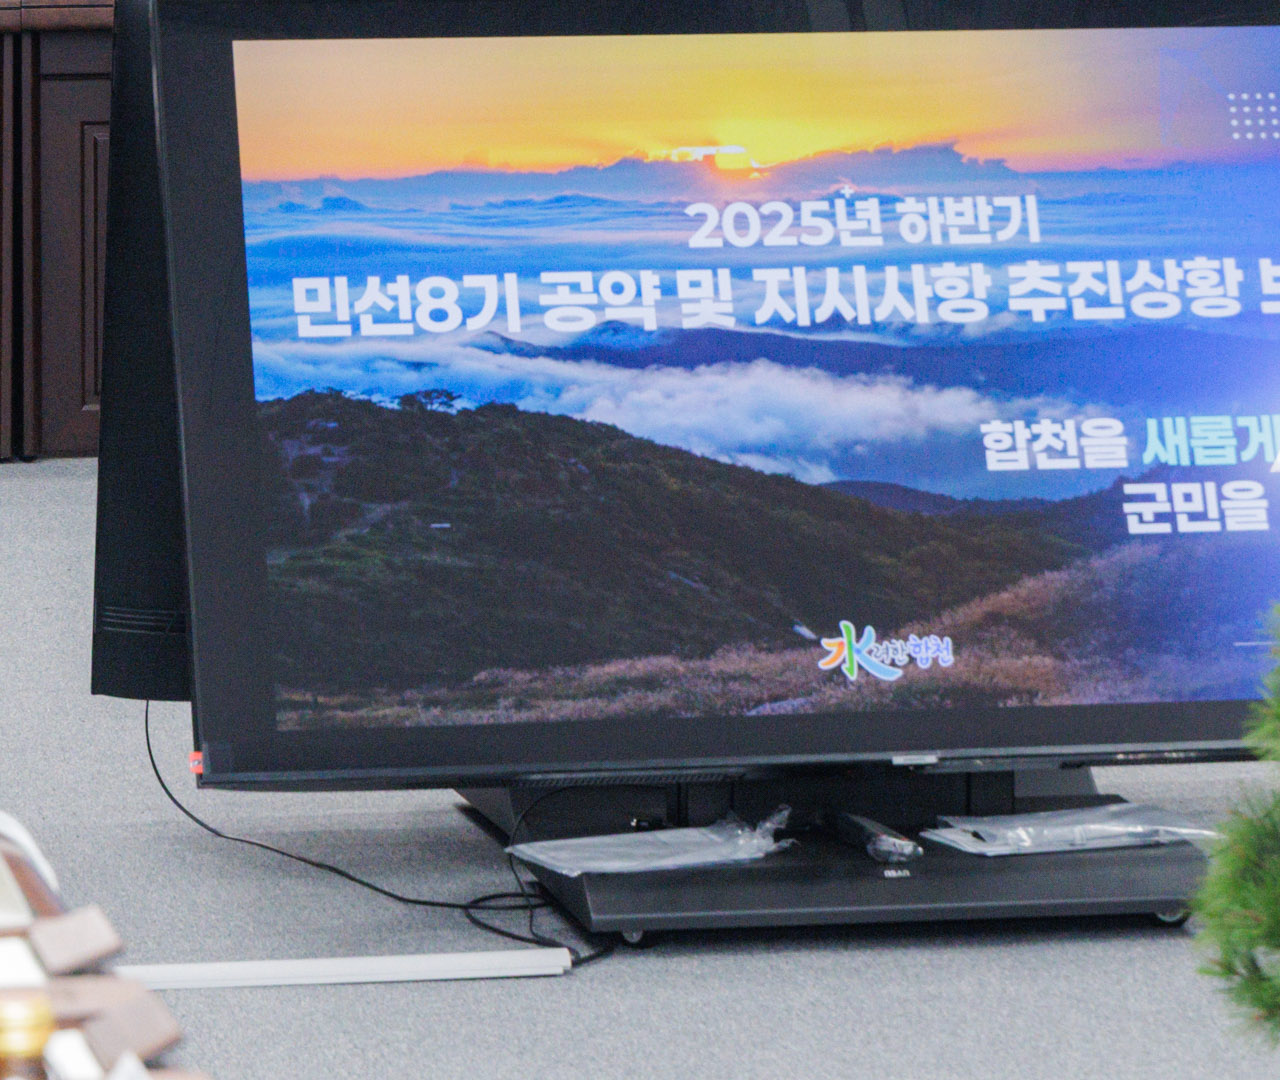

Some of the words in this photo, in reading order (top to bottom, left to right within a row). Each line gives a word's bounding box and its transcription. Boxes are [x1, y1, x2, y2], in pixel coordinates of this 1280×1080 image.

[684, 198, 884, 248] 2025년
[895, 194, 1041, 245] 하반기
[291, 272, 521, 338] 민선8기
[538, 269, 661, 332] 공약
[675, 268, 737, 328] 및
[752, 261, 992, 328] 지시사항
[1007, 256, 1244, 321] 추진상황
[980, 417, 1129, 471] 합천을
[1122, 479, 1269, 535] 군민을
